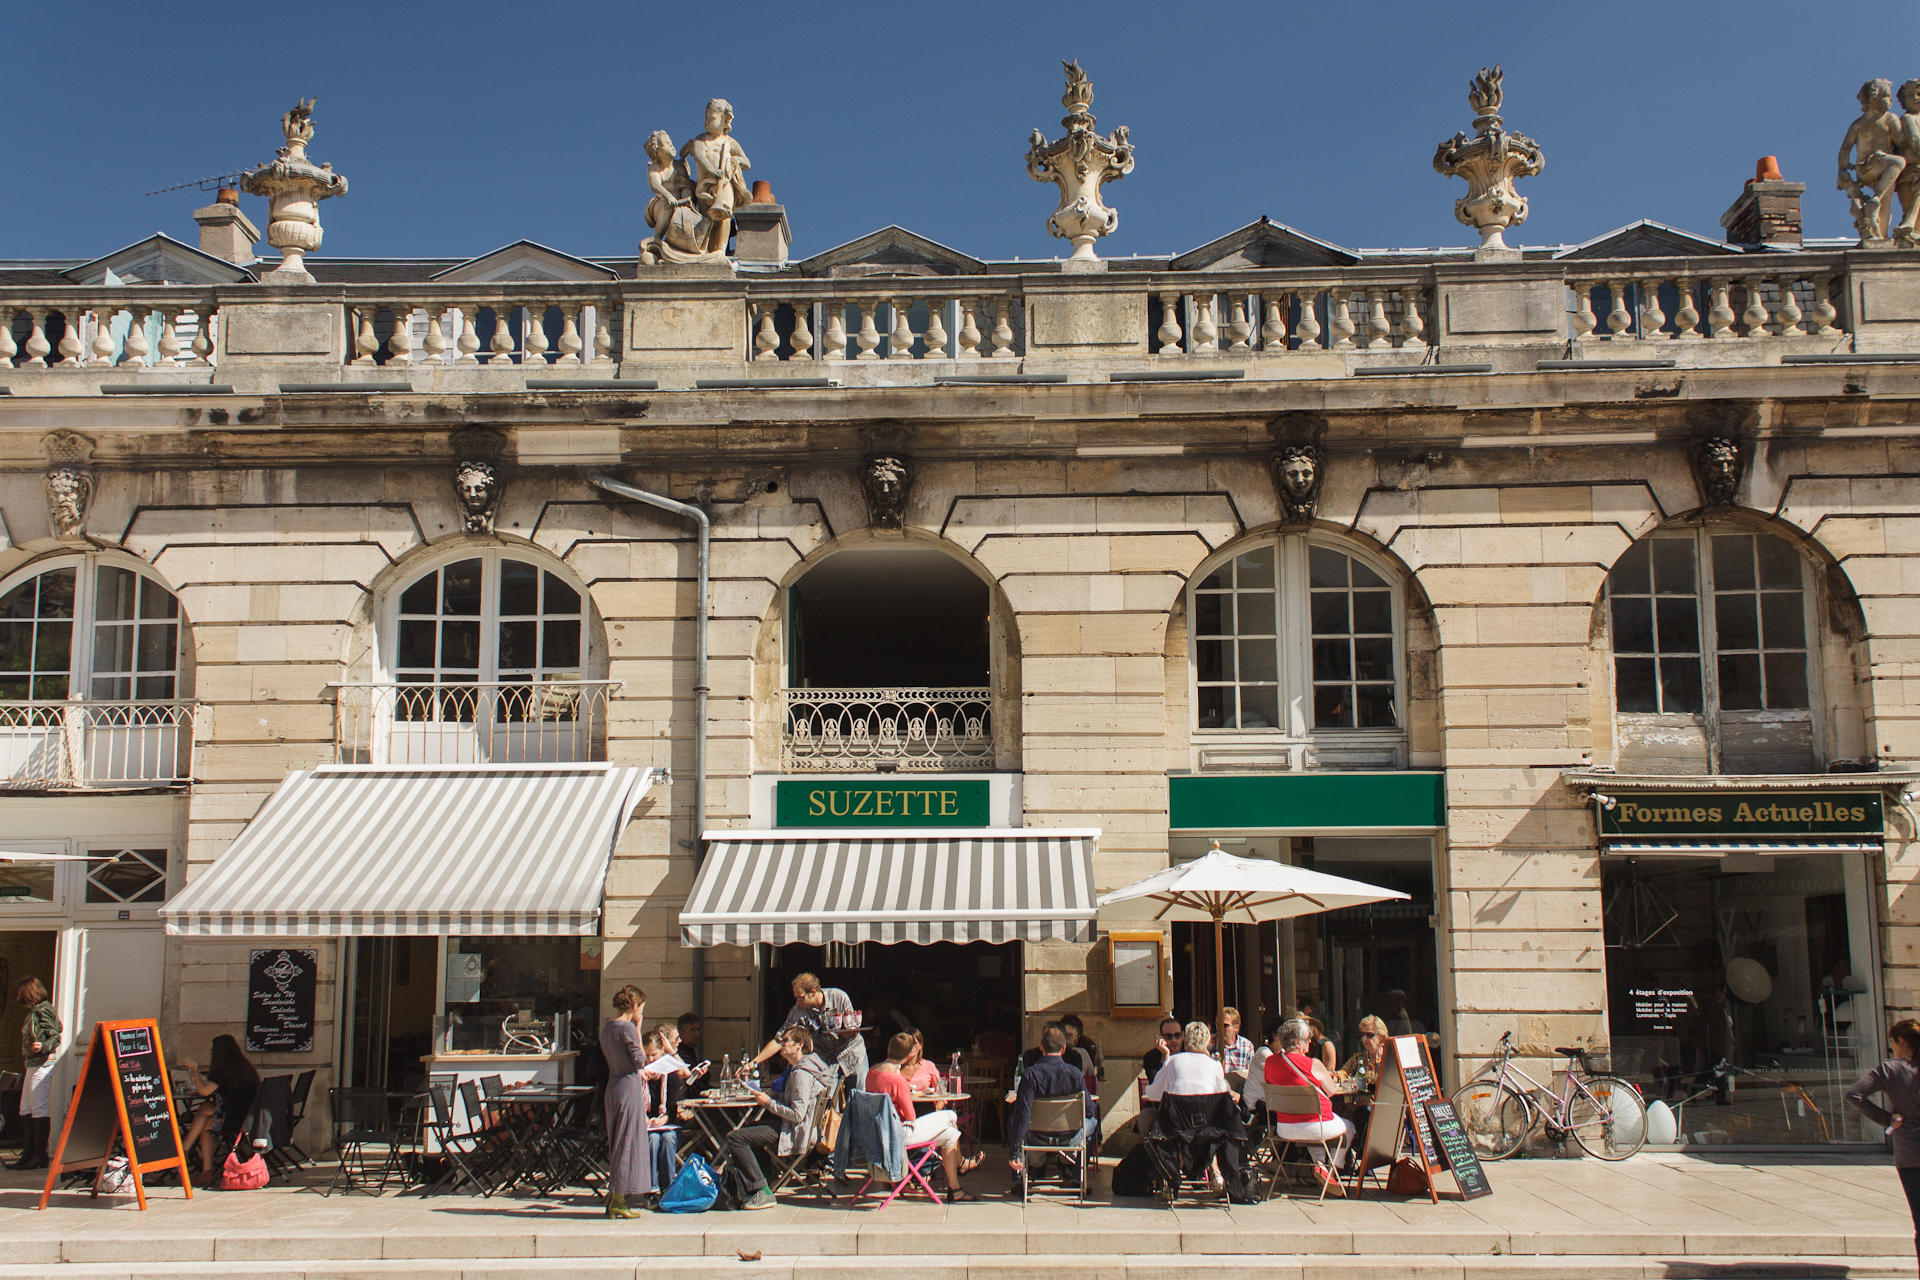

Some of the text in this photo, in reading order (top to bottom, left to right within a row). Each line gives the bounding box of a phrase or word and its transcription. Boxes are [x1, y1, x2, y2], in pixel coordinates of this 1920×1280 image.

[809, 790, 959, 816] SUZETTE
[1618, 801, 1866, 823] Formes Actuelles
[283, 990, 295, 998] Thé
[1635, 989, 1656, 997] étages
[1657, 989, 1694, 997] d'exposition
[253, 1025, 280, 1033] Boissons
[264, 1037, 296, 1046] Smoothies
